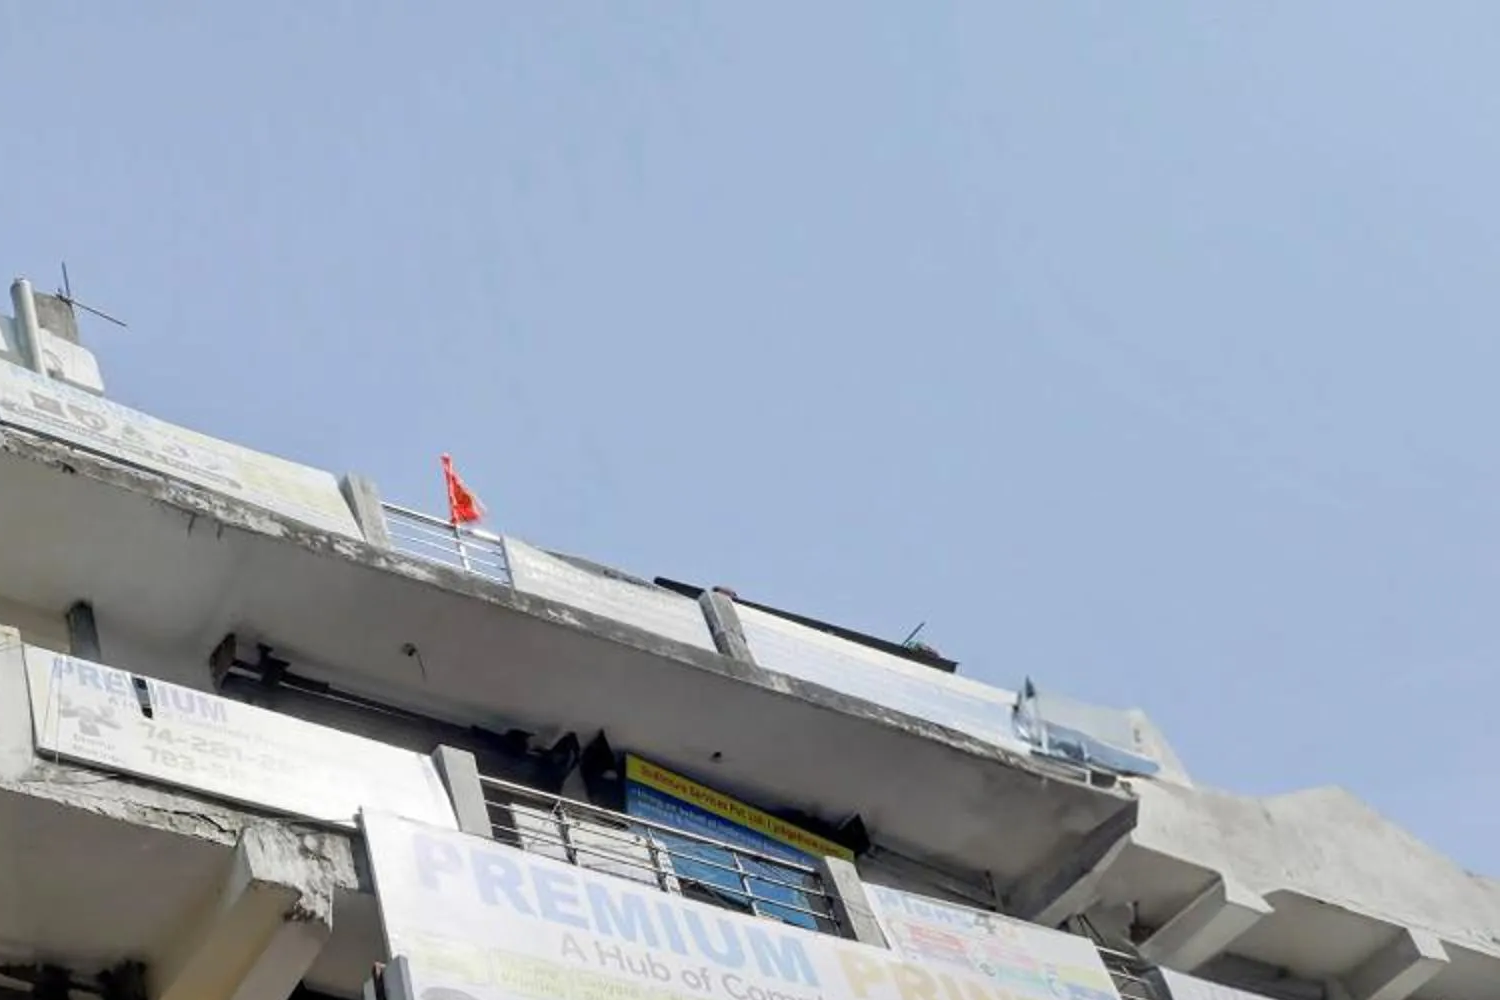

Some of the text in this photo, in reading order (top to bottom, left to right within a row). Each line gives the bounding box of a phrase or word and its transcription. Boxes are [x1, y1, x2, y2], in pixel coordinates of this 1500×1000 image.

[412, 833, 820, 987] PREMIUM
[560, 933, 587, 962] A
[598, 940, 672, 982] Hub
[680, 966, 713, 993] of
